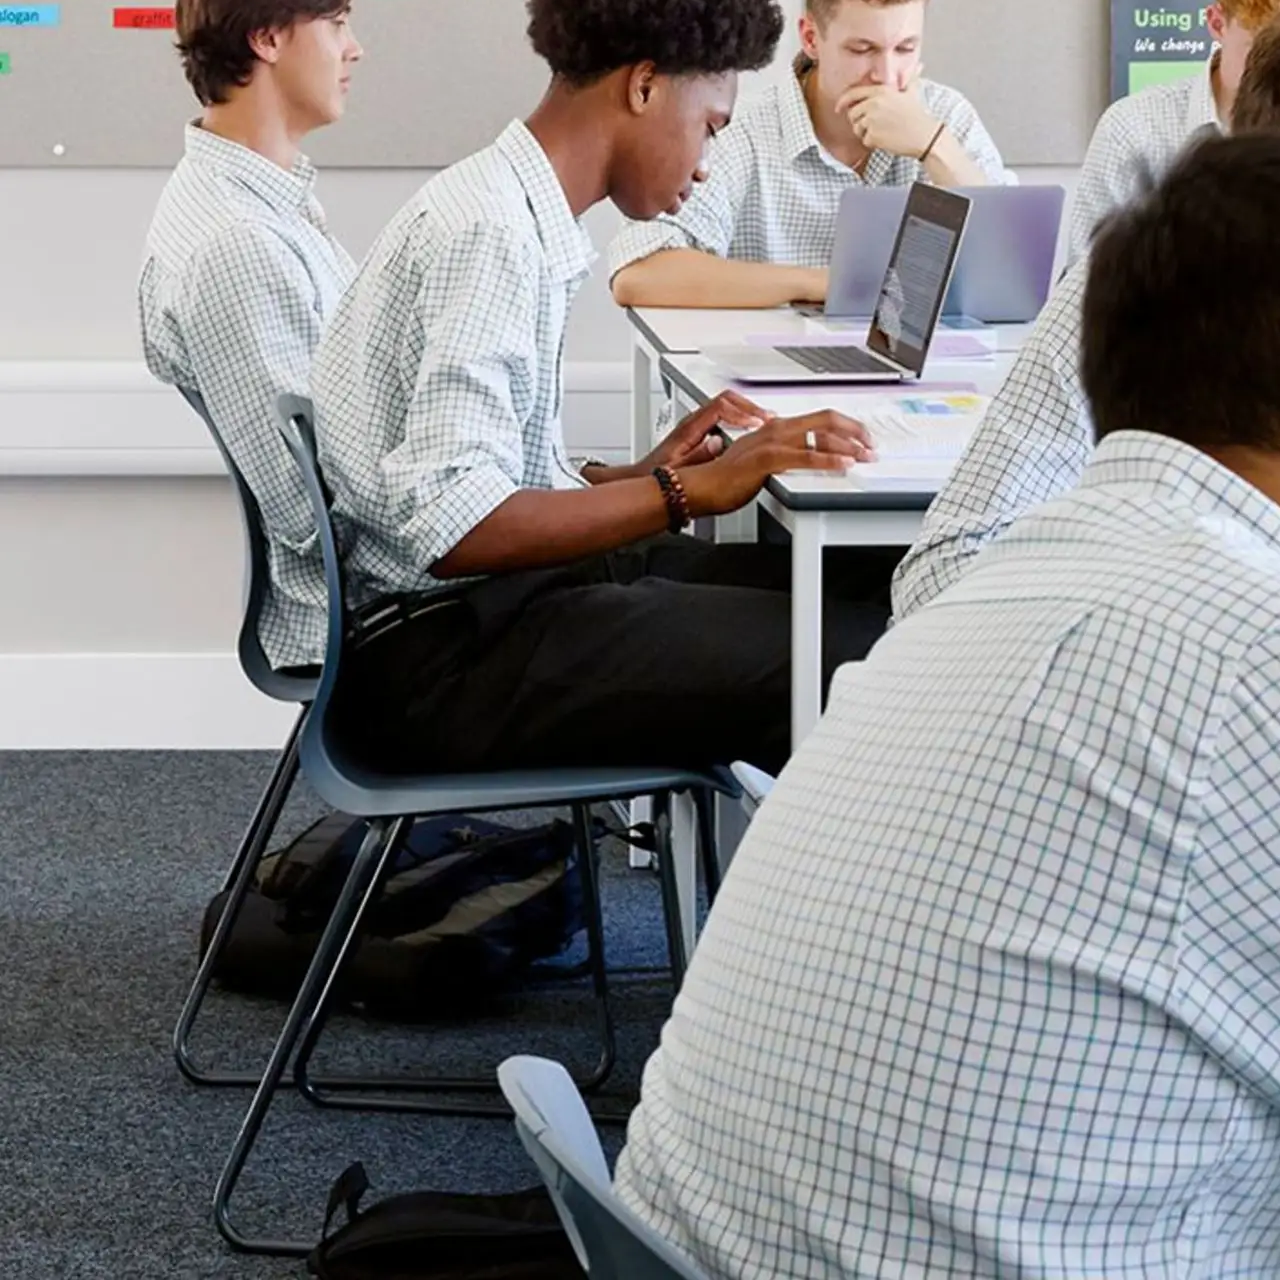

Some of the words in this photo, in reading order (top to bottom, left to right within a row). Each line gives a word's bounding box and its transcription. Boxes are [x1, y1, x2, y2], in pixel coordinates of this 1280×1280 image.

[131, 10, 172, 27] graffit
[1134, 8, 1192, 31] Using
[1135, 38, 1155, 52] We
[1161, 37, 1204, 54] change
